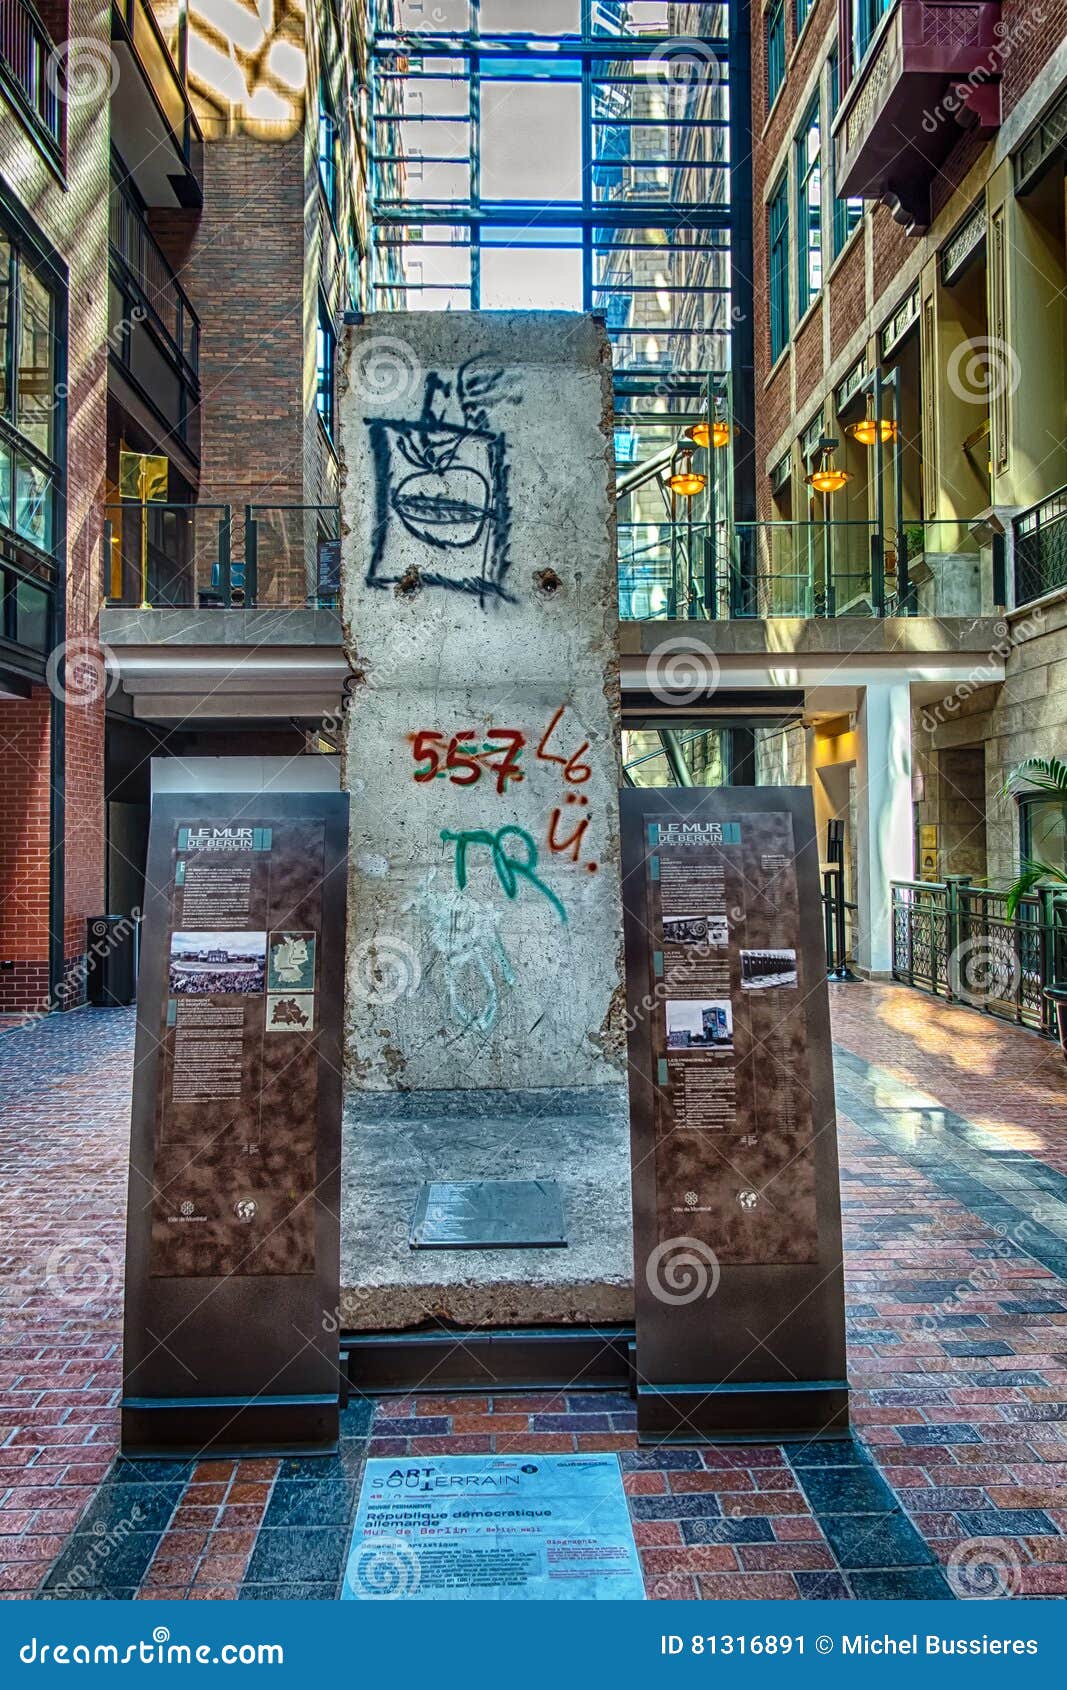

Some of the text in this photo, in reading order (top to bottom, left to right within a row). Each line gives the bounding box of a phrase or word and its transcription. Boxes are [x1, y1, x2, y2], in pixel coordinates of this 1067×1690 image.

[411, 730, 526, 794] 557
[658, 823, 722, 832] LE MUR
[188, 828, 253, 837] LE MUR
[658, 834, 722, 842] DE BERLIN
[187, 839, 253, 847] DE BERLIN
[389, 1467, 435, 1478] ART
[367, 1509, 552, 1521] République démocratique
[365, 1520, 440, 1528] allemande
[363, 1528, 386, 1536] Mur
[420, 1526, 468, 1535] Berlin
